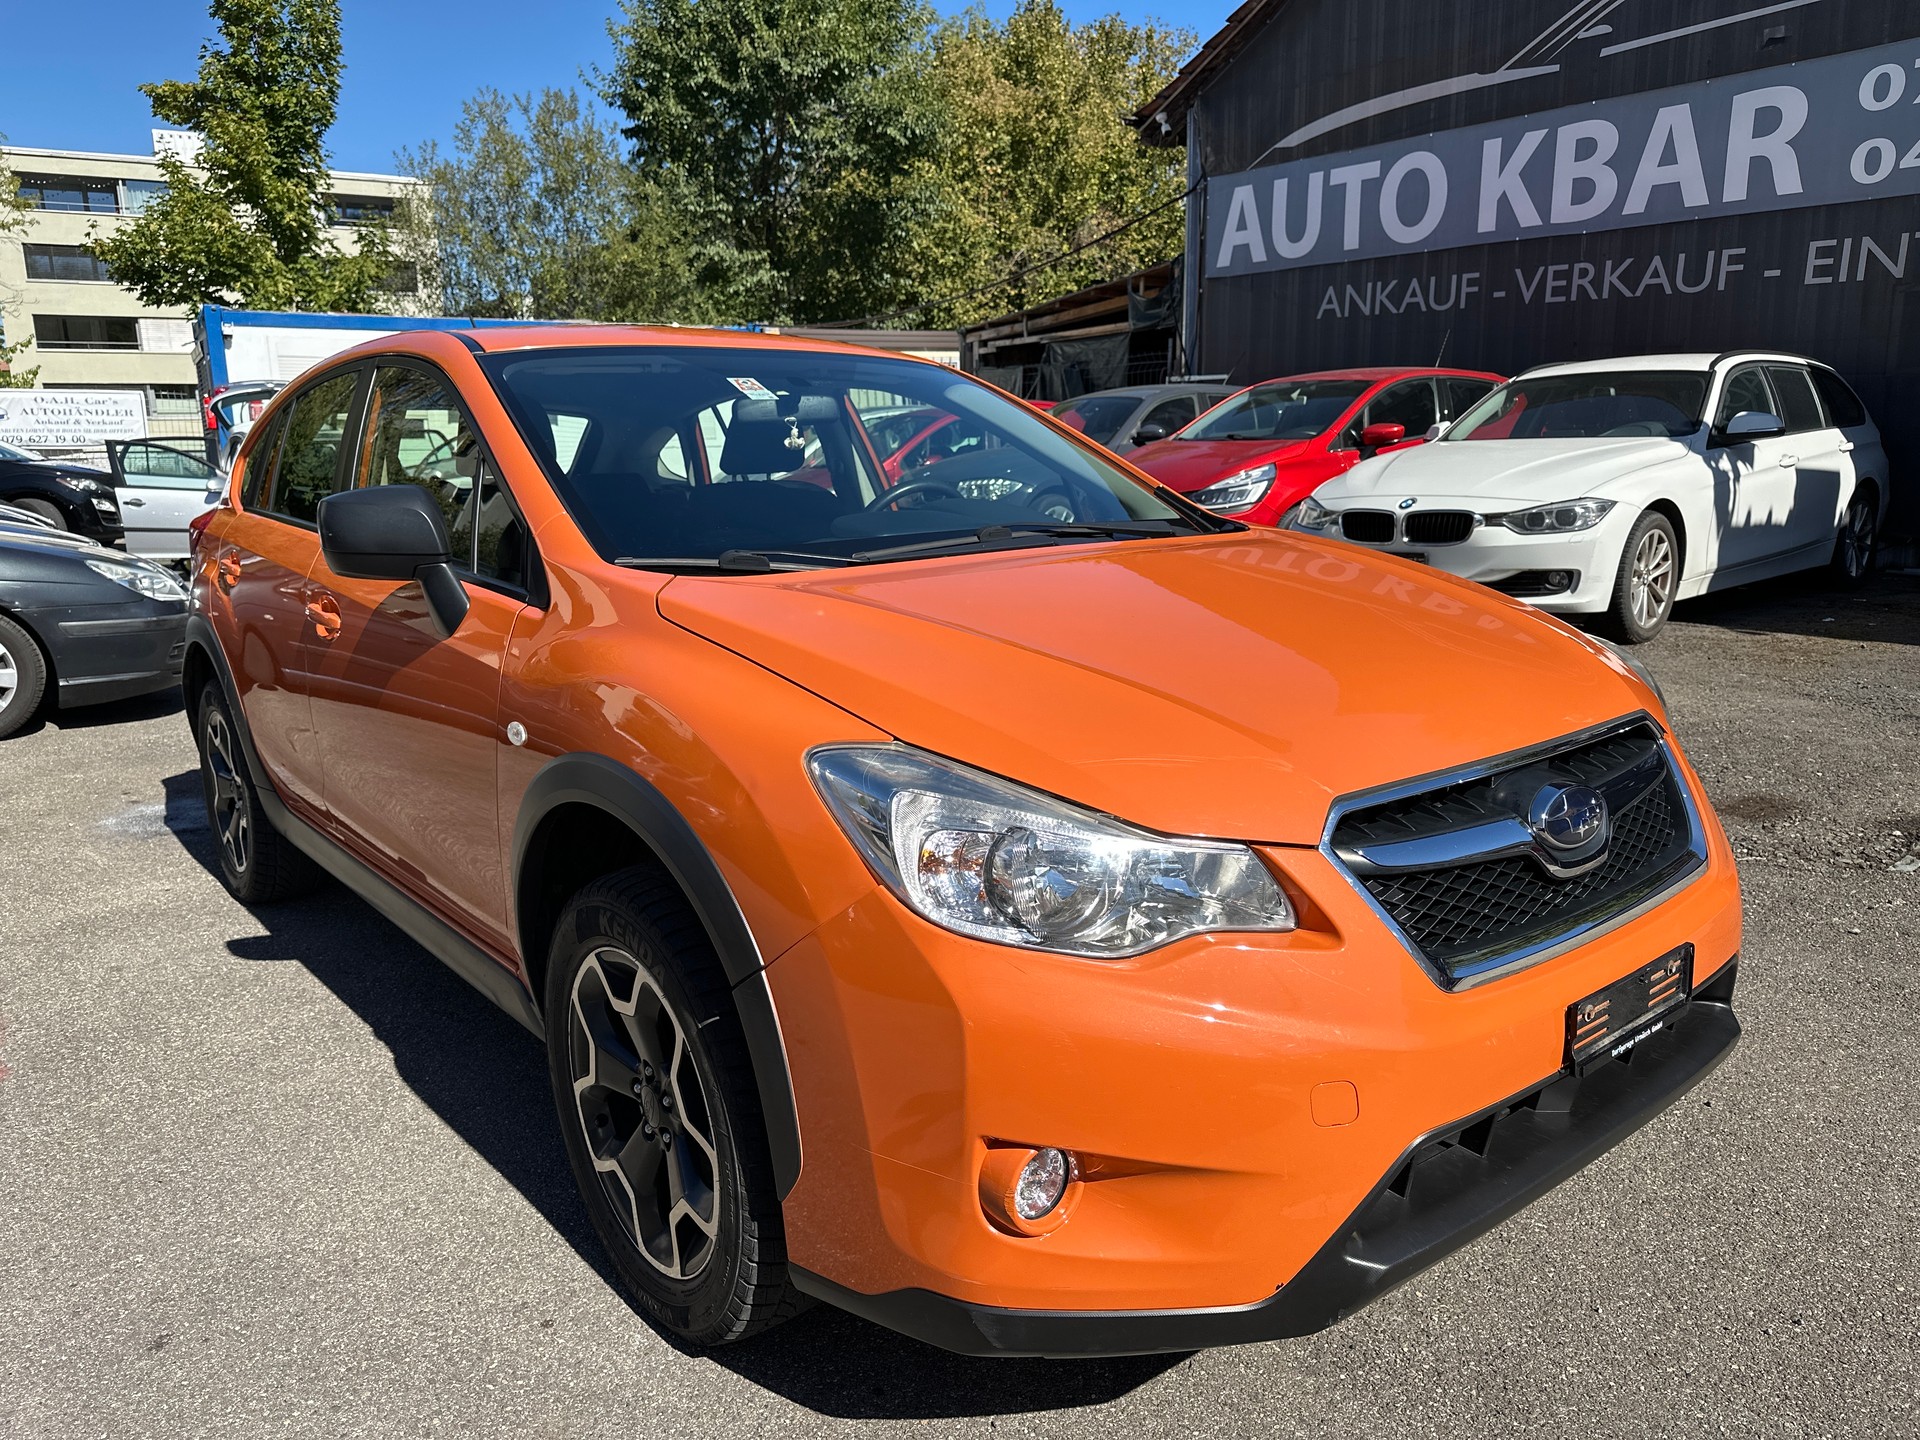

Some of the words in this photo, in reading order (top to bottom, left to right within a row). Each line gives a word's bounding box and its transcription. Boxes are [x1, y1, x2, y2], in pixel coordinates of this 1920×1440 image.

[1216, 151, 1448, 268] AUTO
[1478, 86, 1809, 233] KBAR
[1316, 272, 1480, 320] ANKAUF
[1515, 247, 1747, 306] VERKAUF
[1804, 231, 1920, 285] EIN
[20, 406, 134, 416] AUTOHÄNDLER
[86, 418, 124, 426] Verkauf
[1, 435, 23, 444] 079
[28, 435, 49, 444] 627
[55, 435, 66, 444] 19
[71, 435, 86, 444] 00
